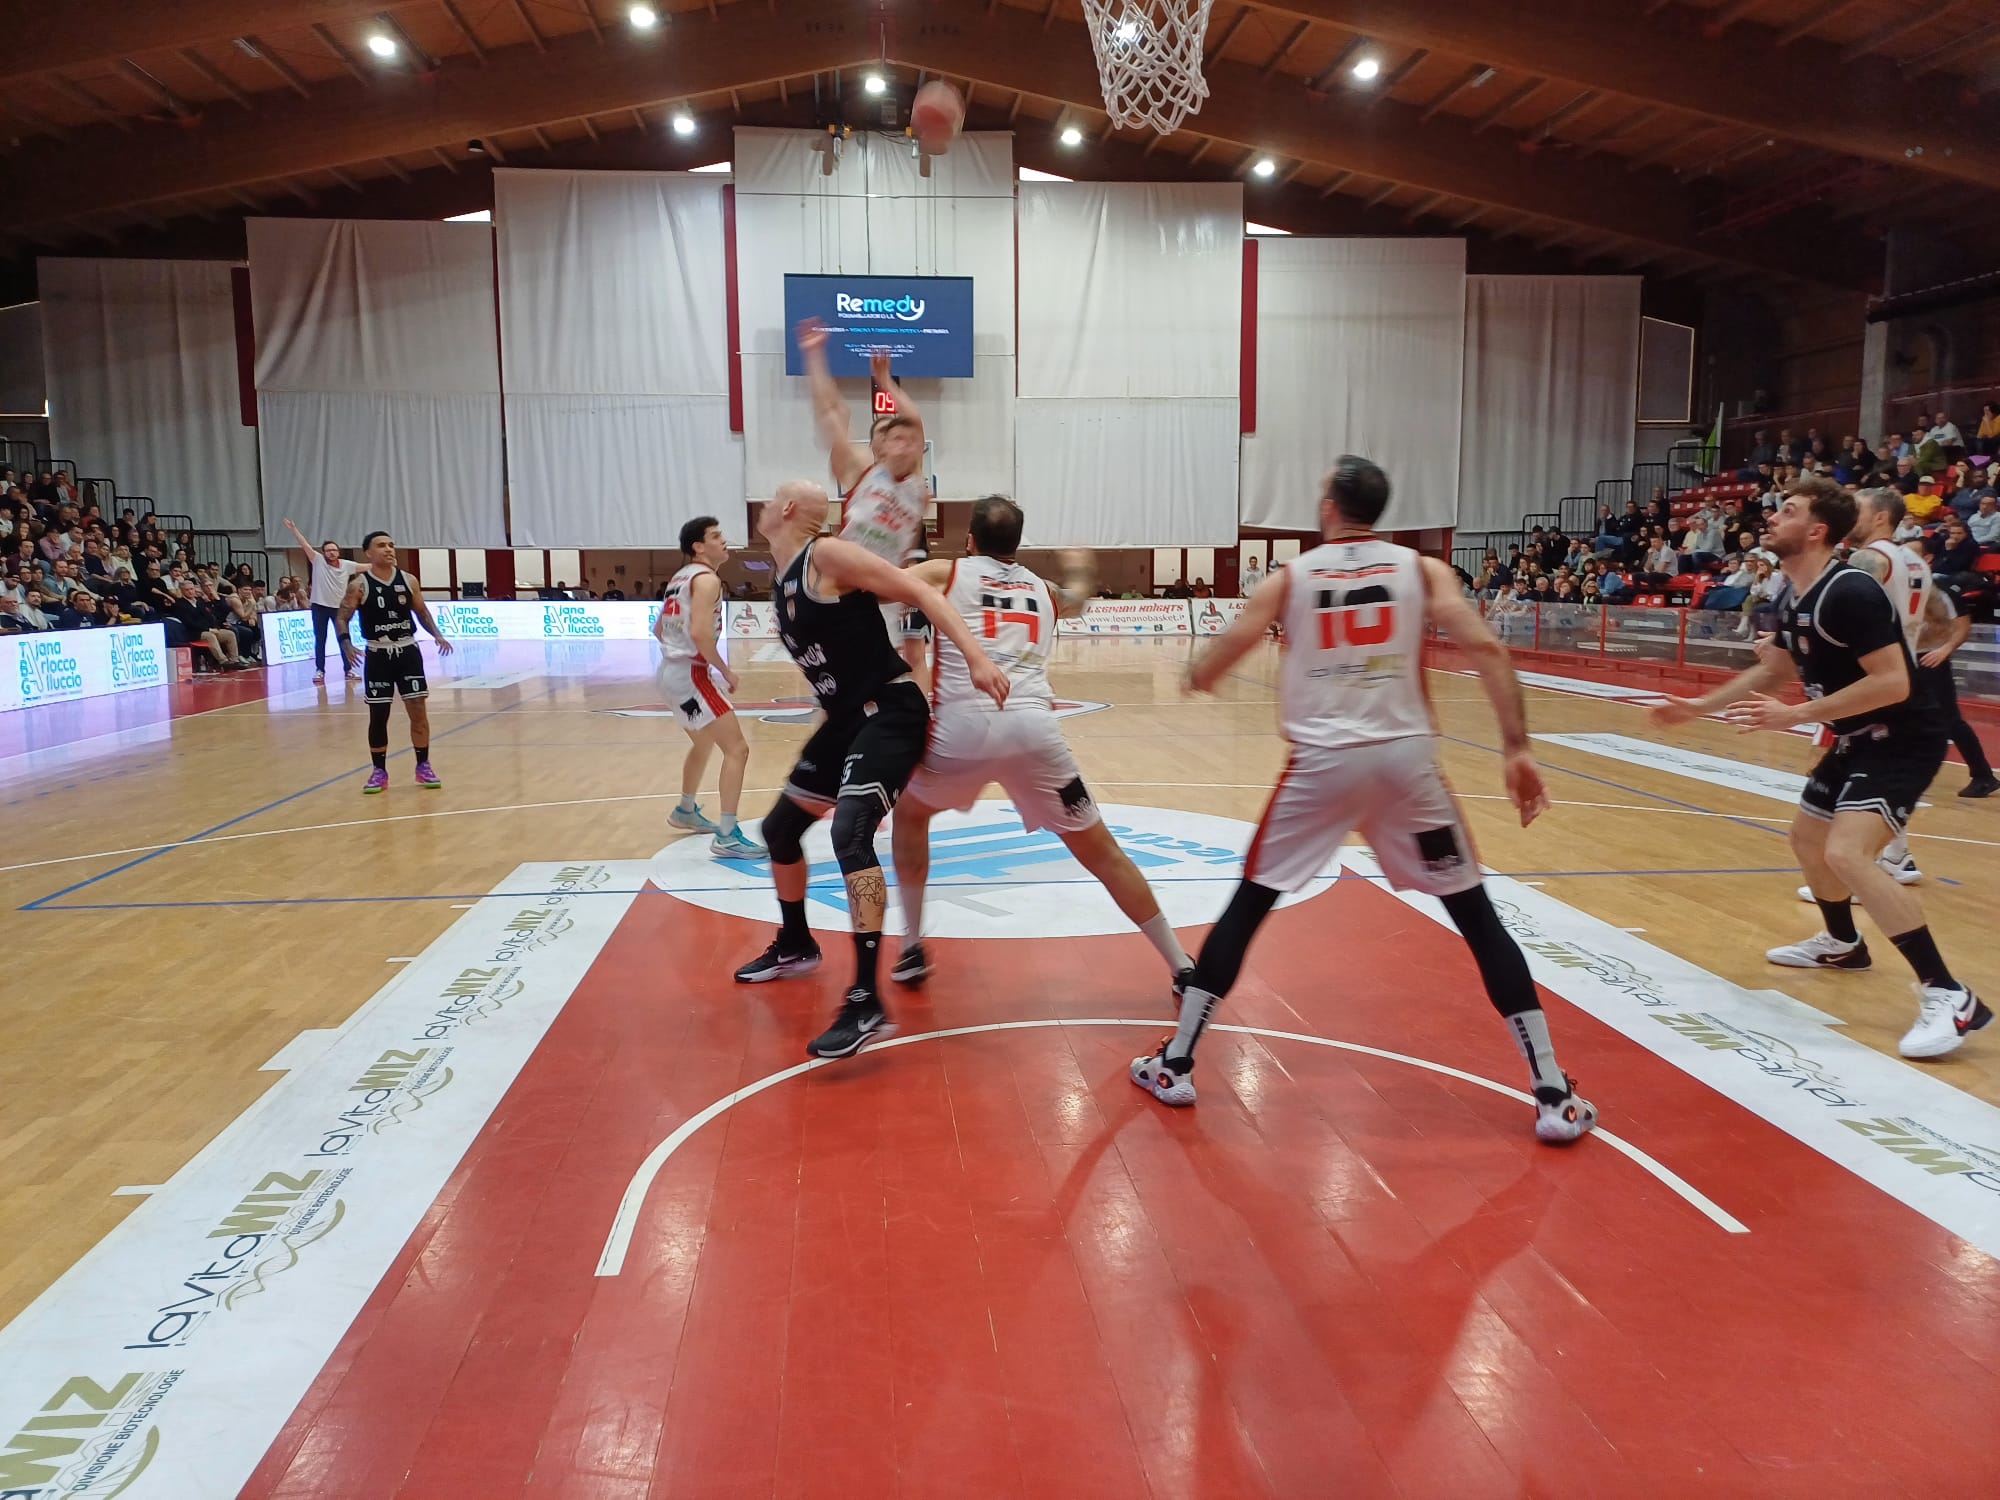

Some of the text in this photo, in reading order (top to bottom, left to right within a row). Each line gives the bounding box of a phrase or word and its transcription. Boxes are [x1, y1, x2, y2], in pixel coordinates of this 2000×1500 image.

[837, 293, 925, 321] Remedy
[377, 596, 385, 608] 0
[1315, 585, 1393, 650] 10
[72, 1369, 185, 1491] DIVISIONE BIOTECNOLOGIE
